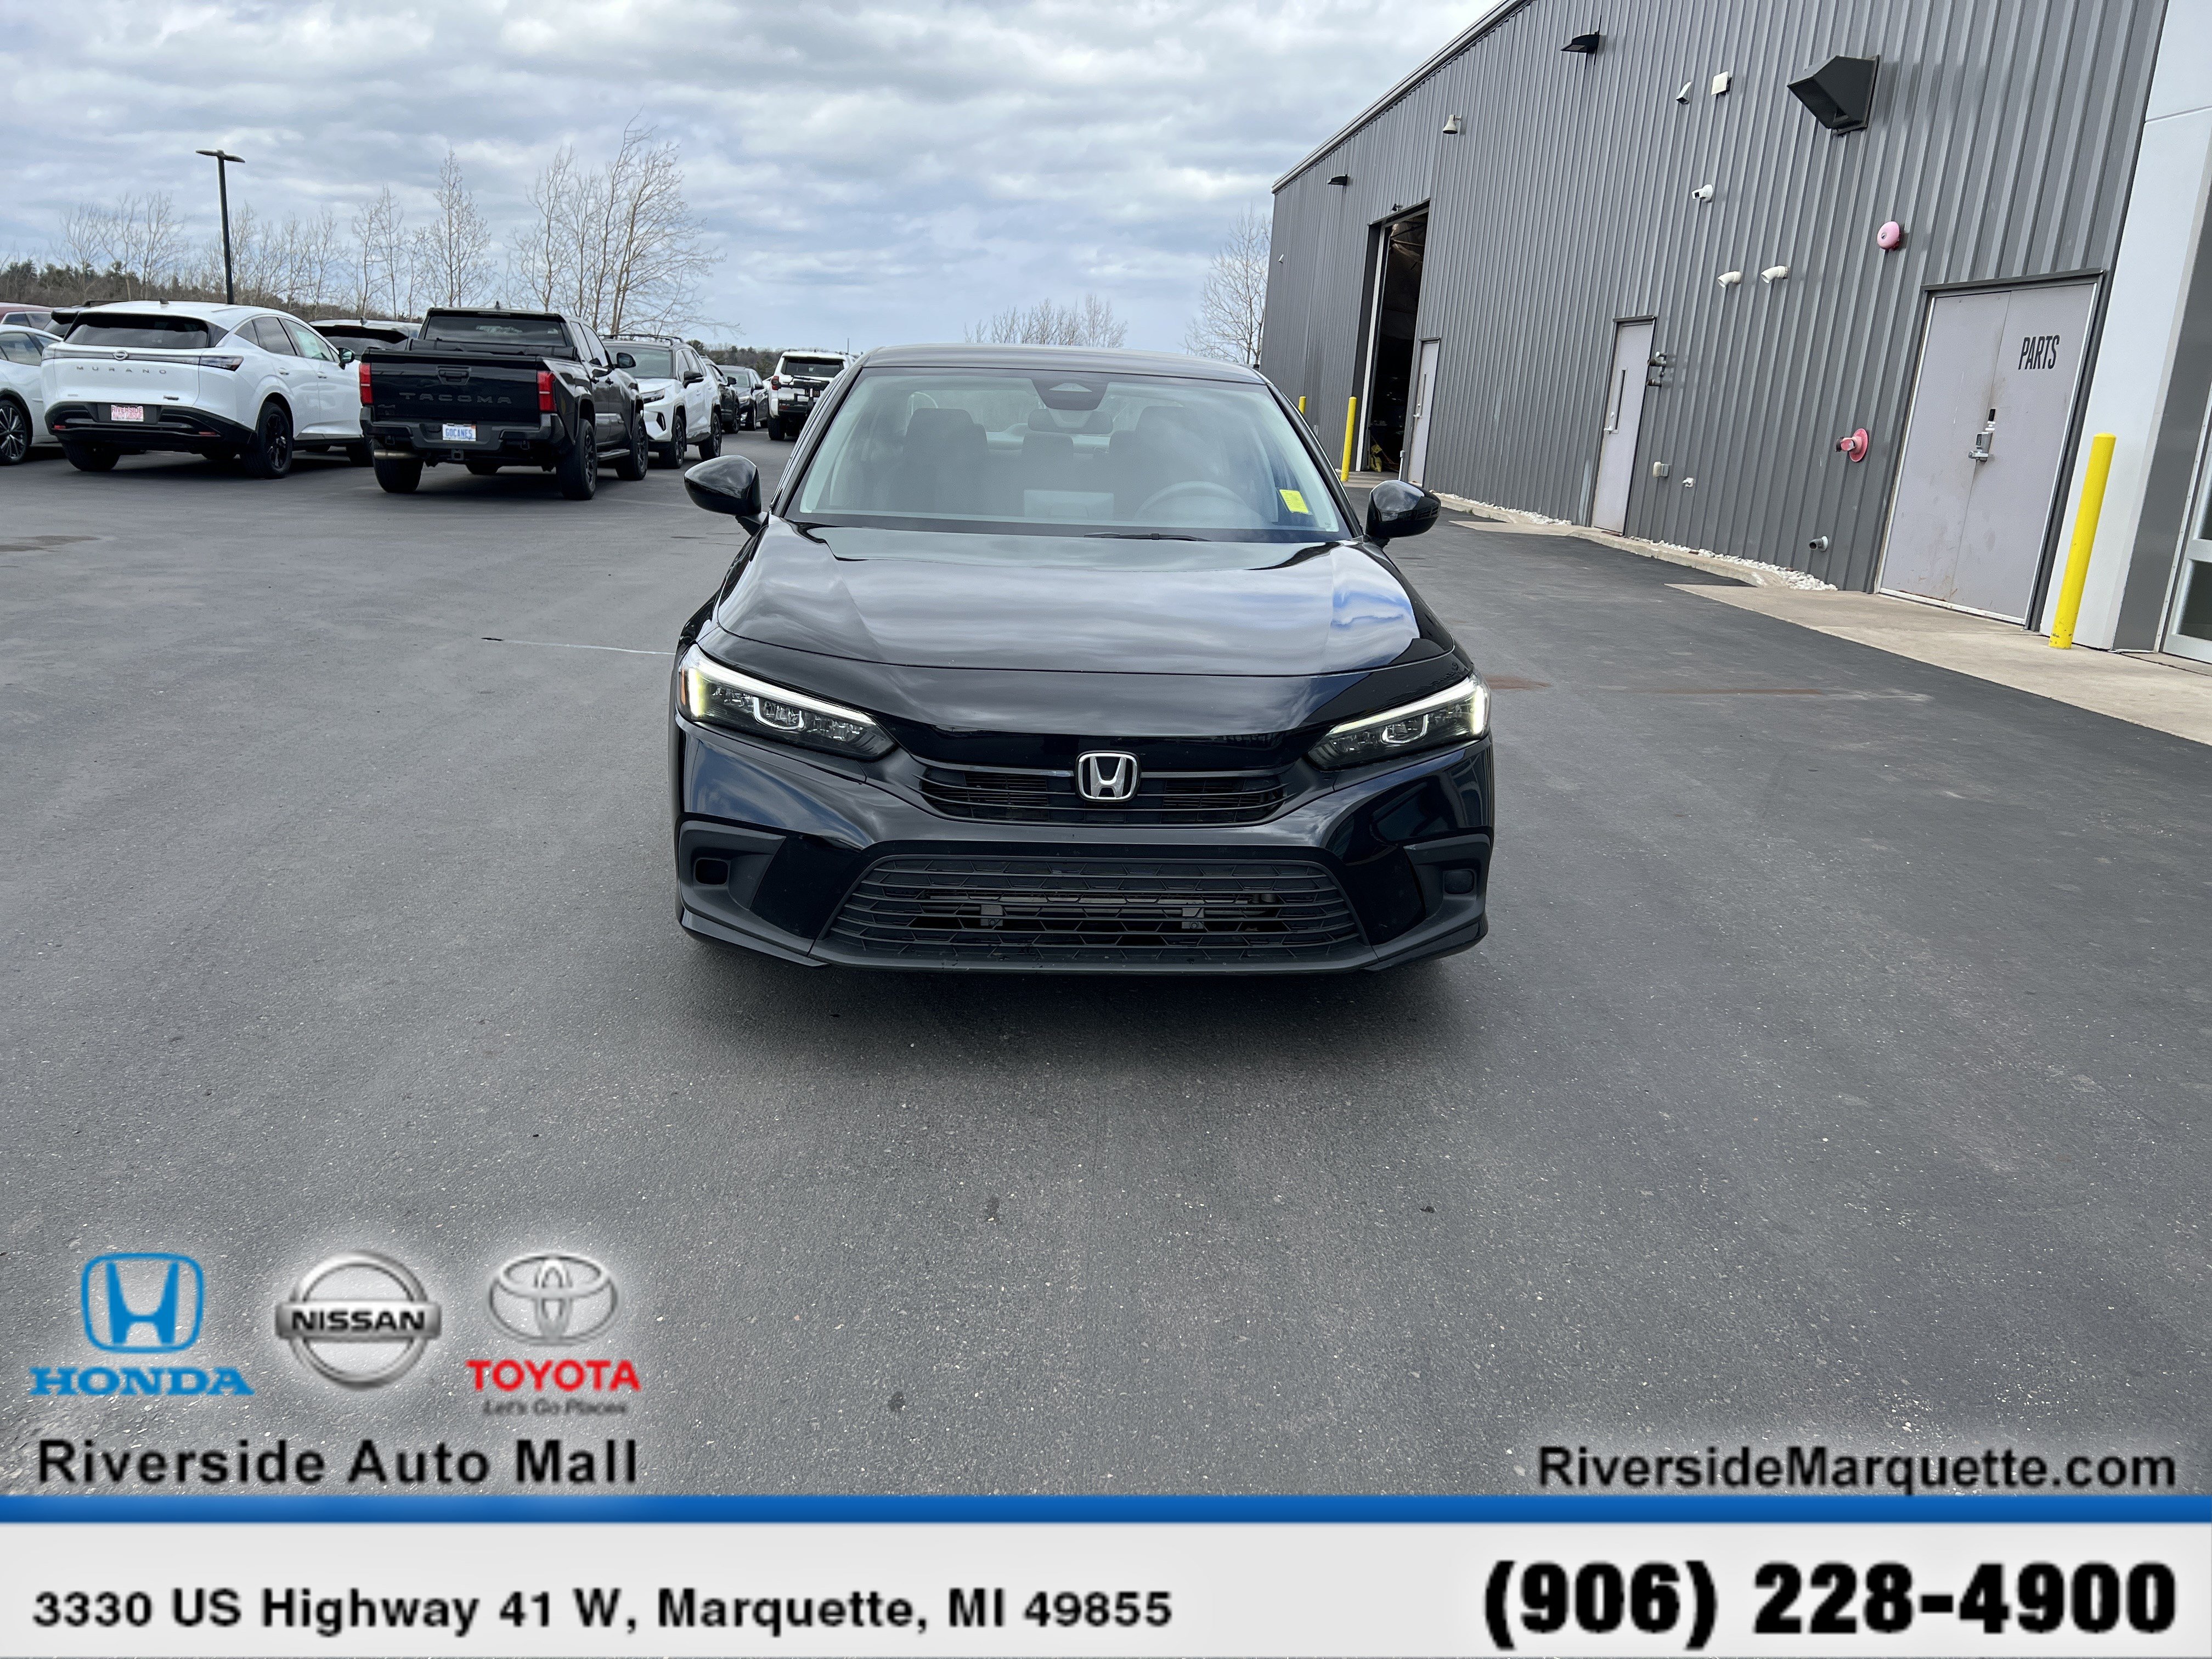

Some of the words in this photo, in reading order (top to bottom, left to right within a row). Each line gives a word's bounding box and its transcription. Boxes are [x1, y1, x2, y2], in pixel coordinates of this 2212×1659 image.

[2018, 334, 2060, 370] PARTS
[76, 365, 167, 375] MURANO
[399, 392, 512, 404] TACOMA
[445, 428, 472, 438] GOCANES
